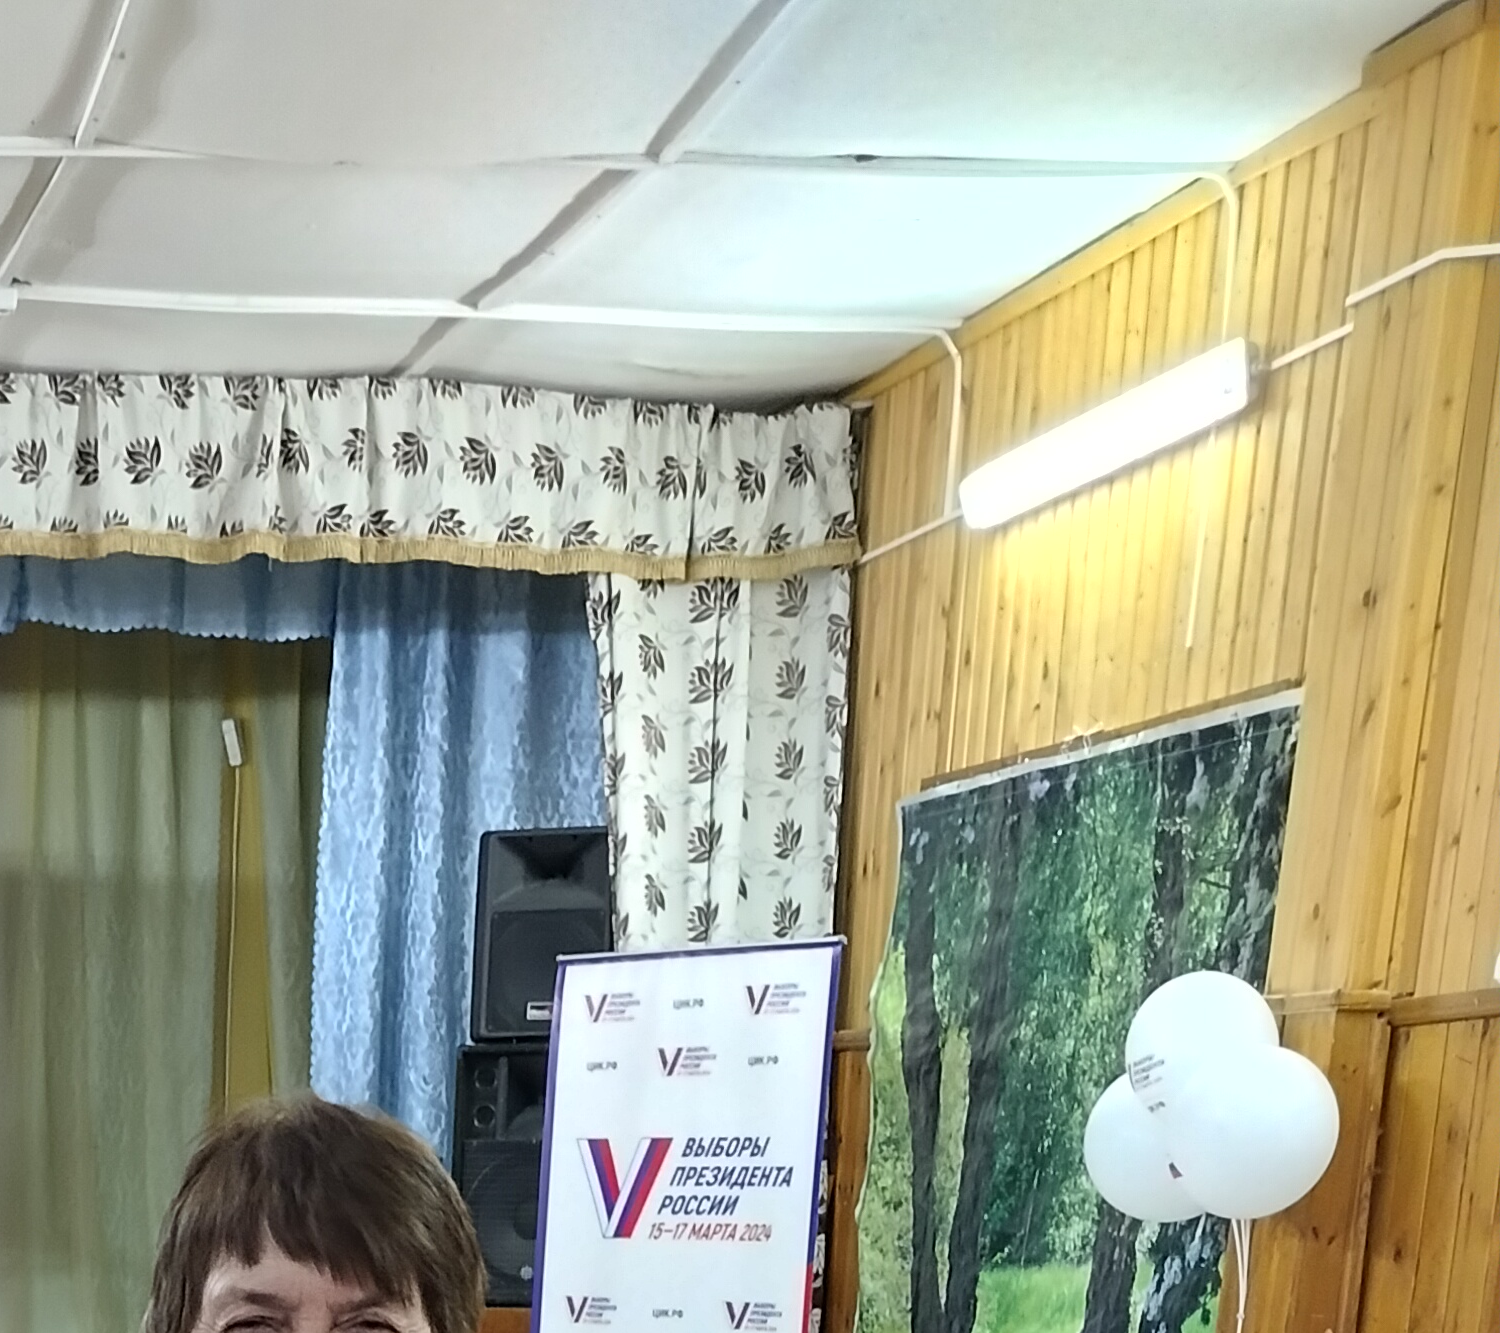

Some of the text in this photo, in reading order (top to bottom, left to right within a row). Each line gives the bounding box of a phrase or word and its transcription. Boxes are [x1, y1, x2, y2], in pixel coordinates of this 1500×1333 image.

[681, 1136, 771, 1157] ВЫБОРЫ
[669, 1166, 794, 1190] ПРЕЗИДЕНТА
[657, 1195, 740, 1215] РОССИИ
[688, 1223, 738, 1241] МАРТА
[739, 1224, 772, 1242] 2024
